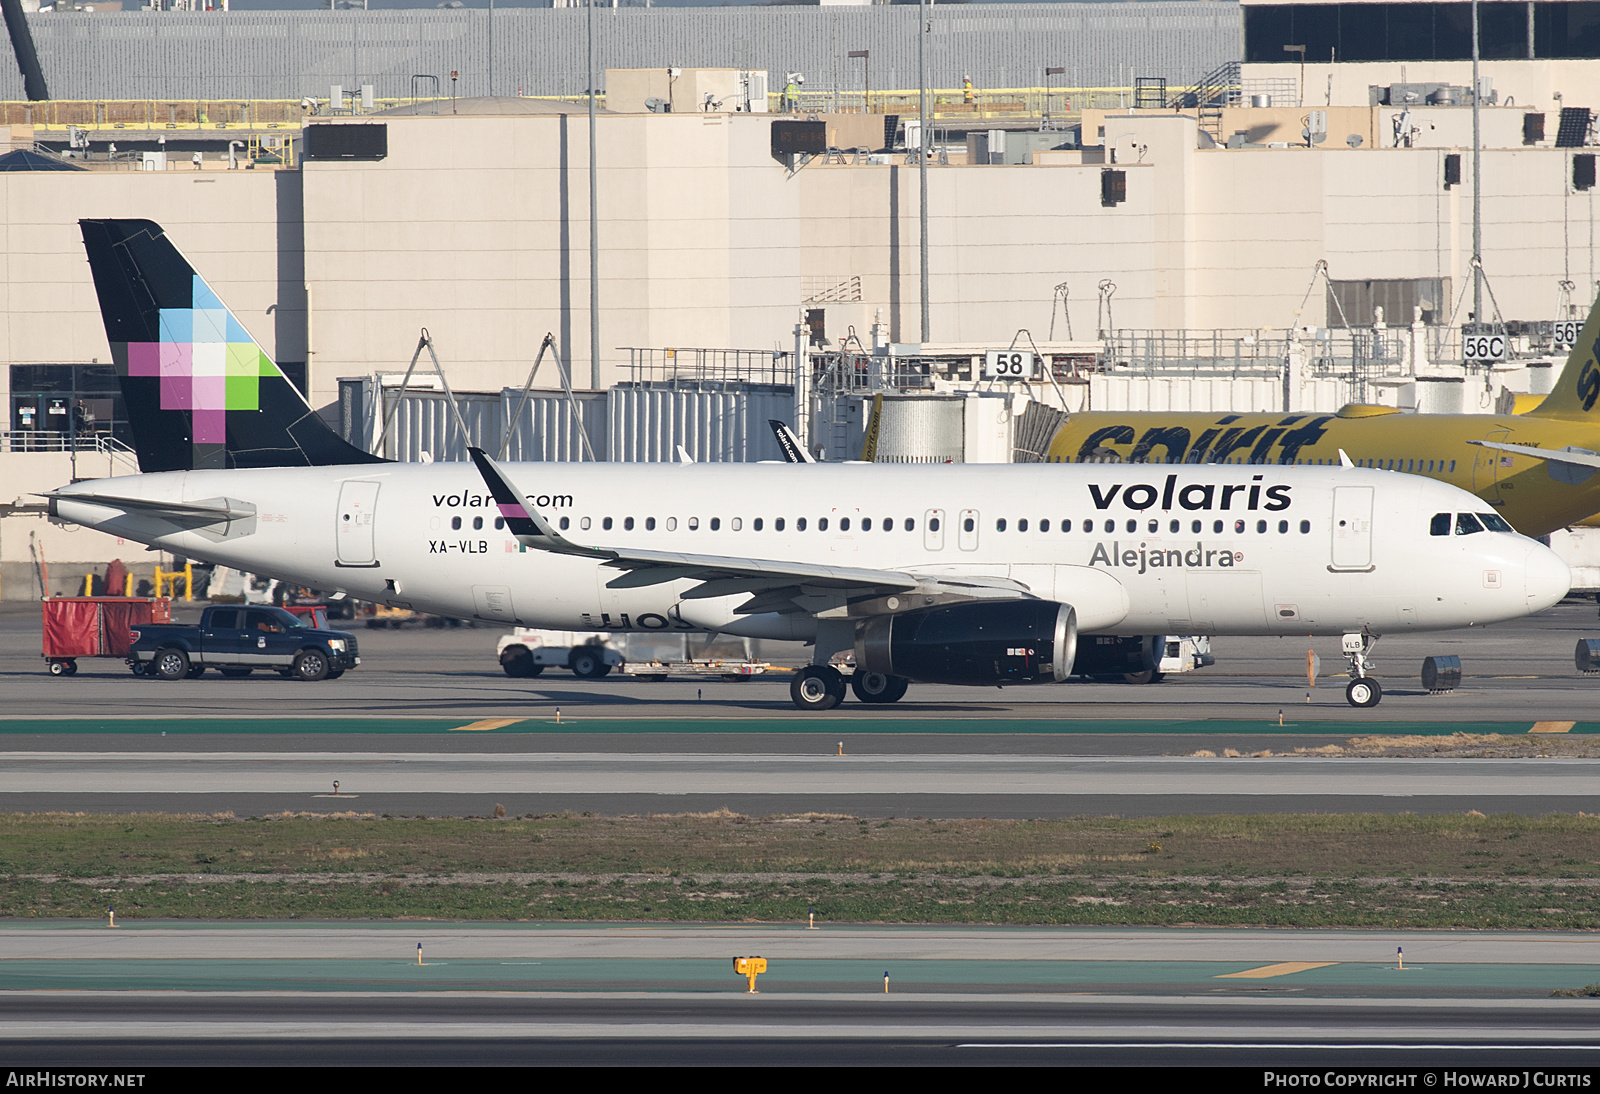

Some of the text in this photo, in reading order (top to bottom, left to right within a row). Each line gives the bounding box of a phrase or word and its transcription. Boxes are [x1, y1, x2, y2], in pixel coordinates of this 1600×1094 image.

[1465, 337, 1504, 358] 56C
[996, 353, 1023, 375] 58
[776, 428, 799, 464] volaris.com
[1087, 474, 1293, 512] volaris
[429, 540, 488, 553] XA-VLB
[1088, 541, 1234, 574] Alejandra
[1345, 641, 1361, 649] VLB
